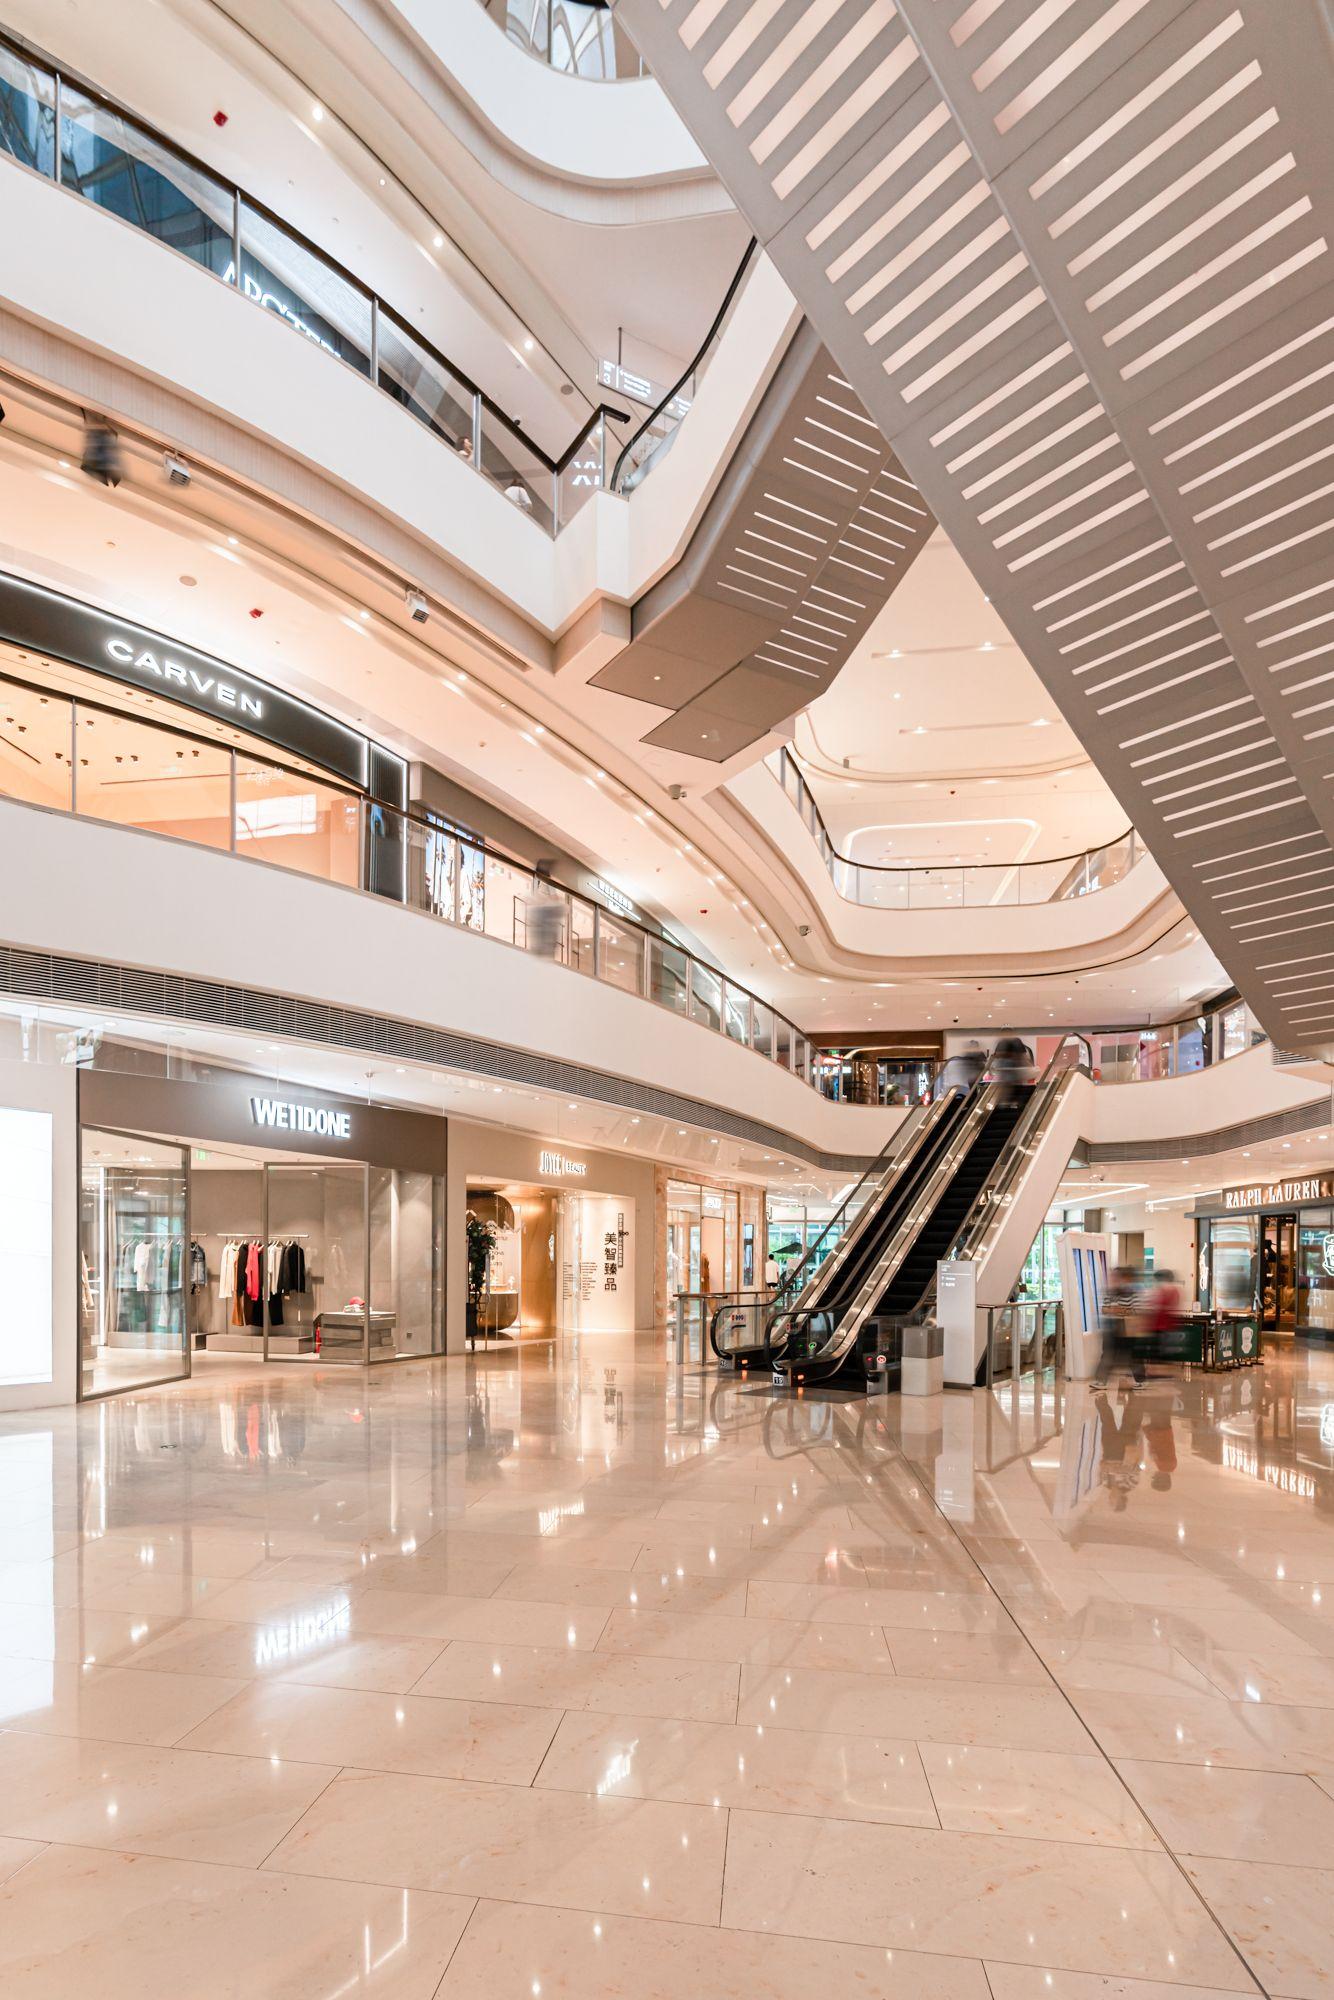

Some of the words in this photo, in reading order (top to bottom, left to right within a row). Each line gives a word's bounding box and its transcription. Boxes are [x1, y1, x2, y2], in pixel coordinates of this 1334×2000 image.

[107, 640, 262, 718] CARVEN
[251, 1097, 351, 1138] WE11DONE
[1226, 1188, 1262, 1208] RALPH
[1268, 1180, 1319, 1204] LAUREN
[604, 1231, 618, 1291] 美智臻品
